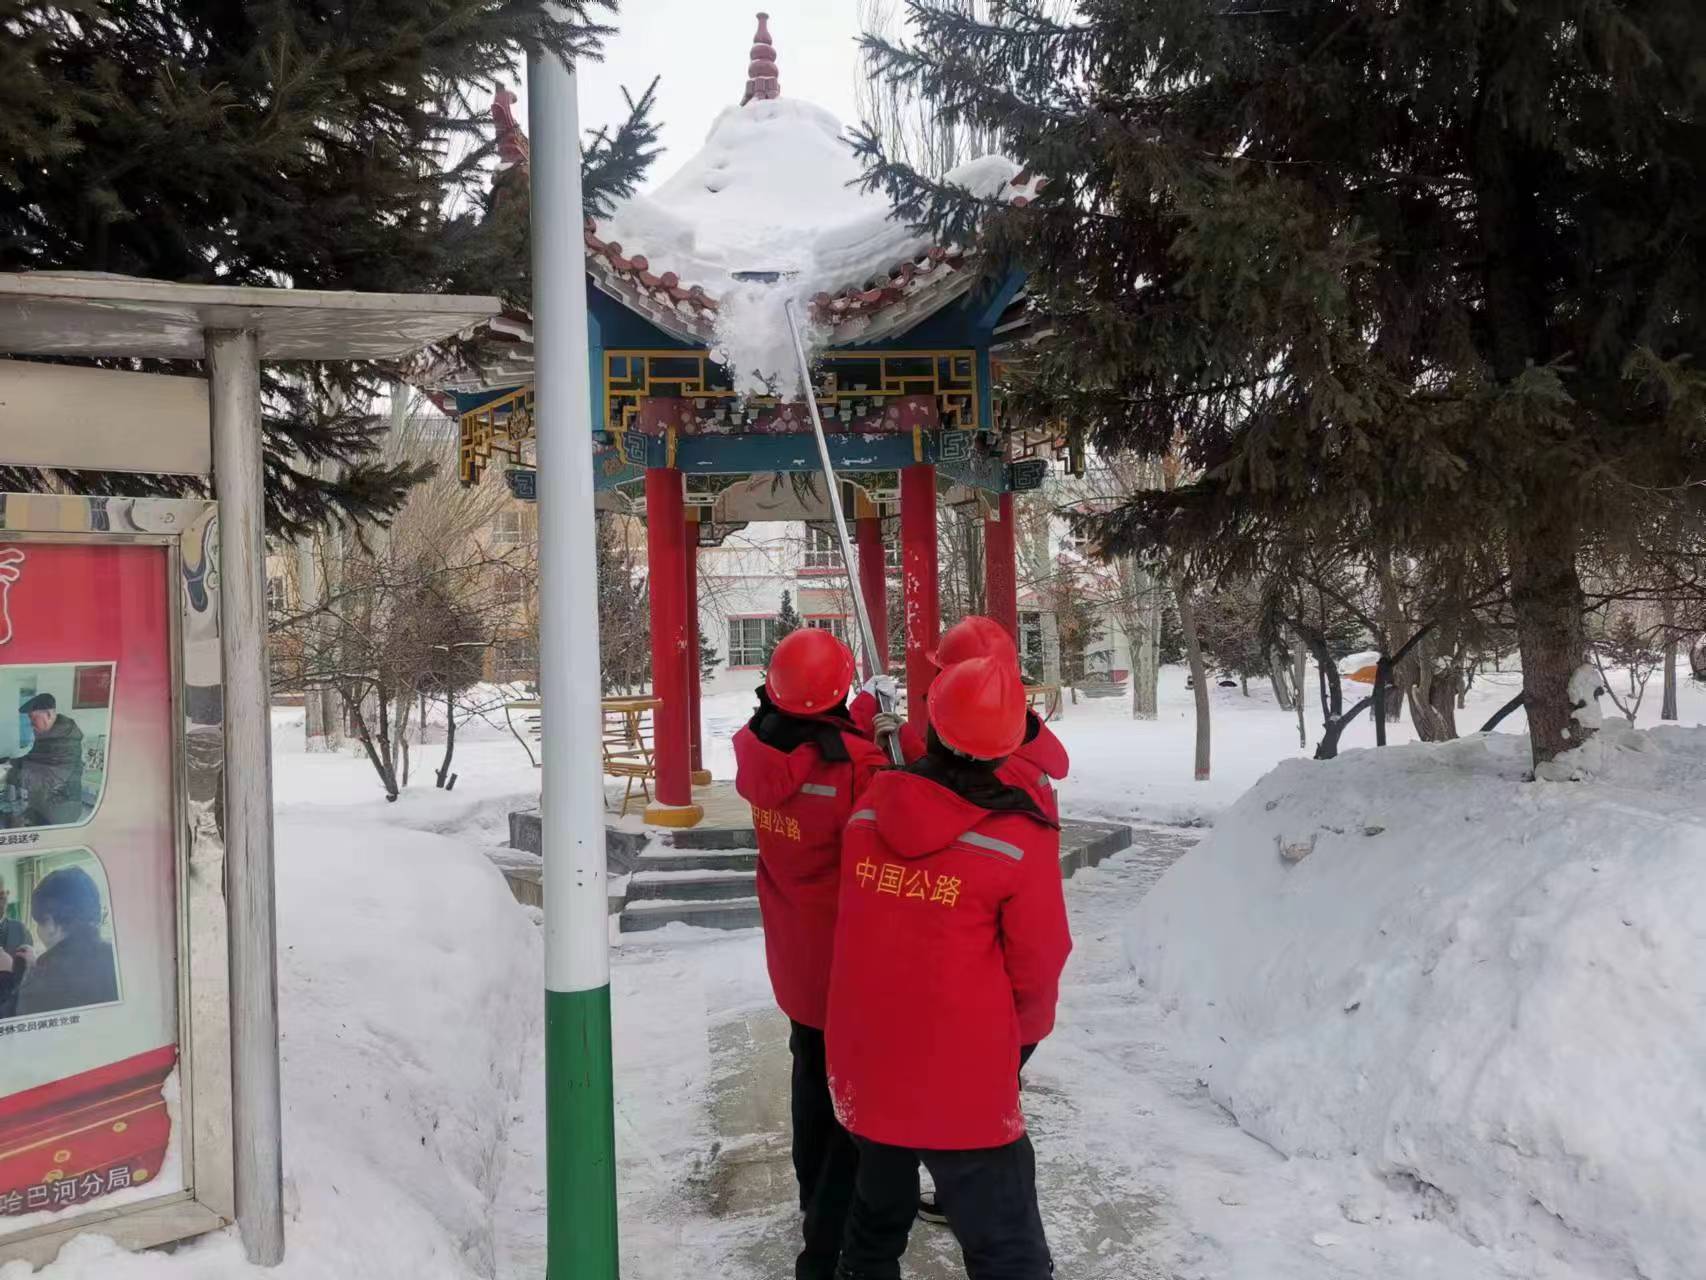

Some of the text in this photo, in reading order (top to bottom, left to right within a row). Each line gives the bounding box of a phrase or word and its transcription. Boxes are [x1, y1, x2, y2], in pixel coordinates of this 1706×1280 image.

[856, 856, 961, 907] 中国公路
[0, 1166, 131, 1213] 哈巴河分局
